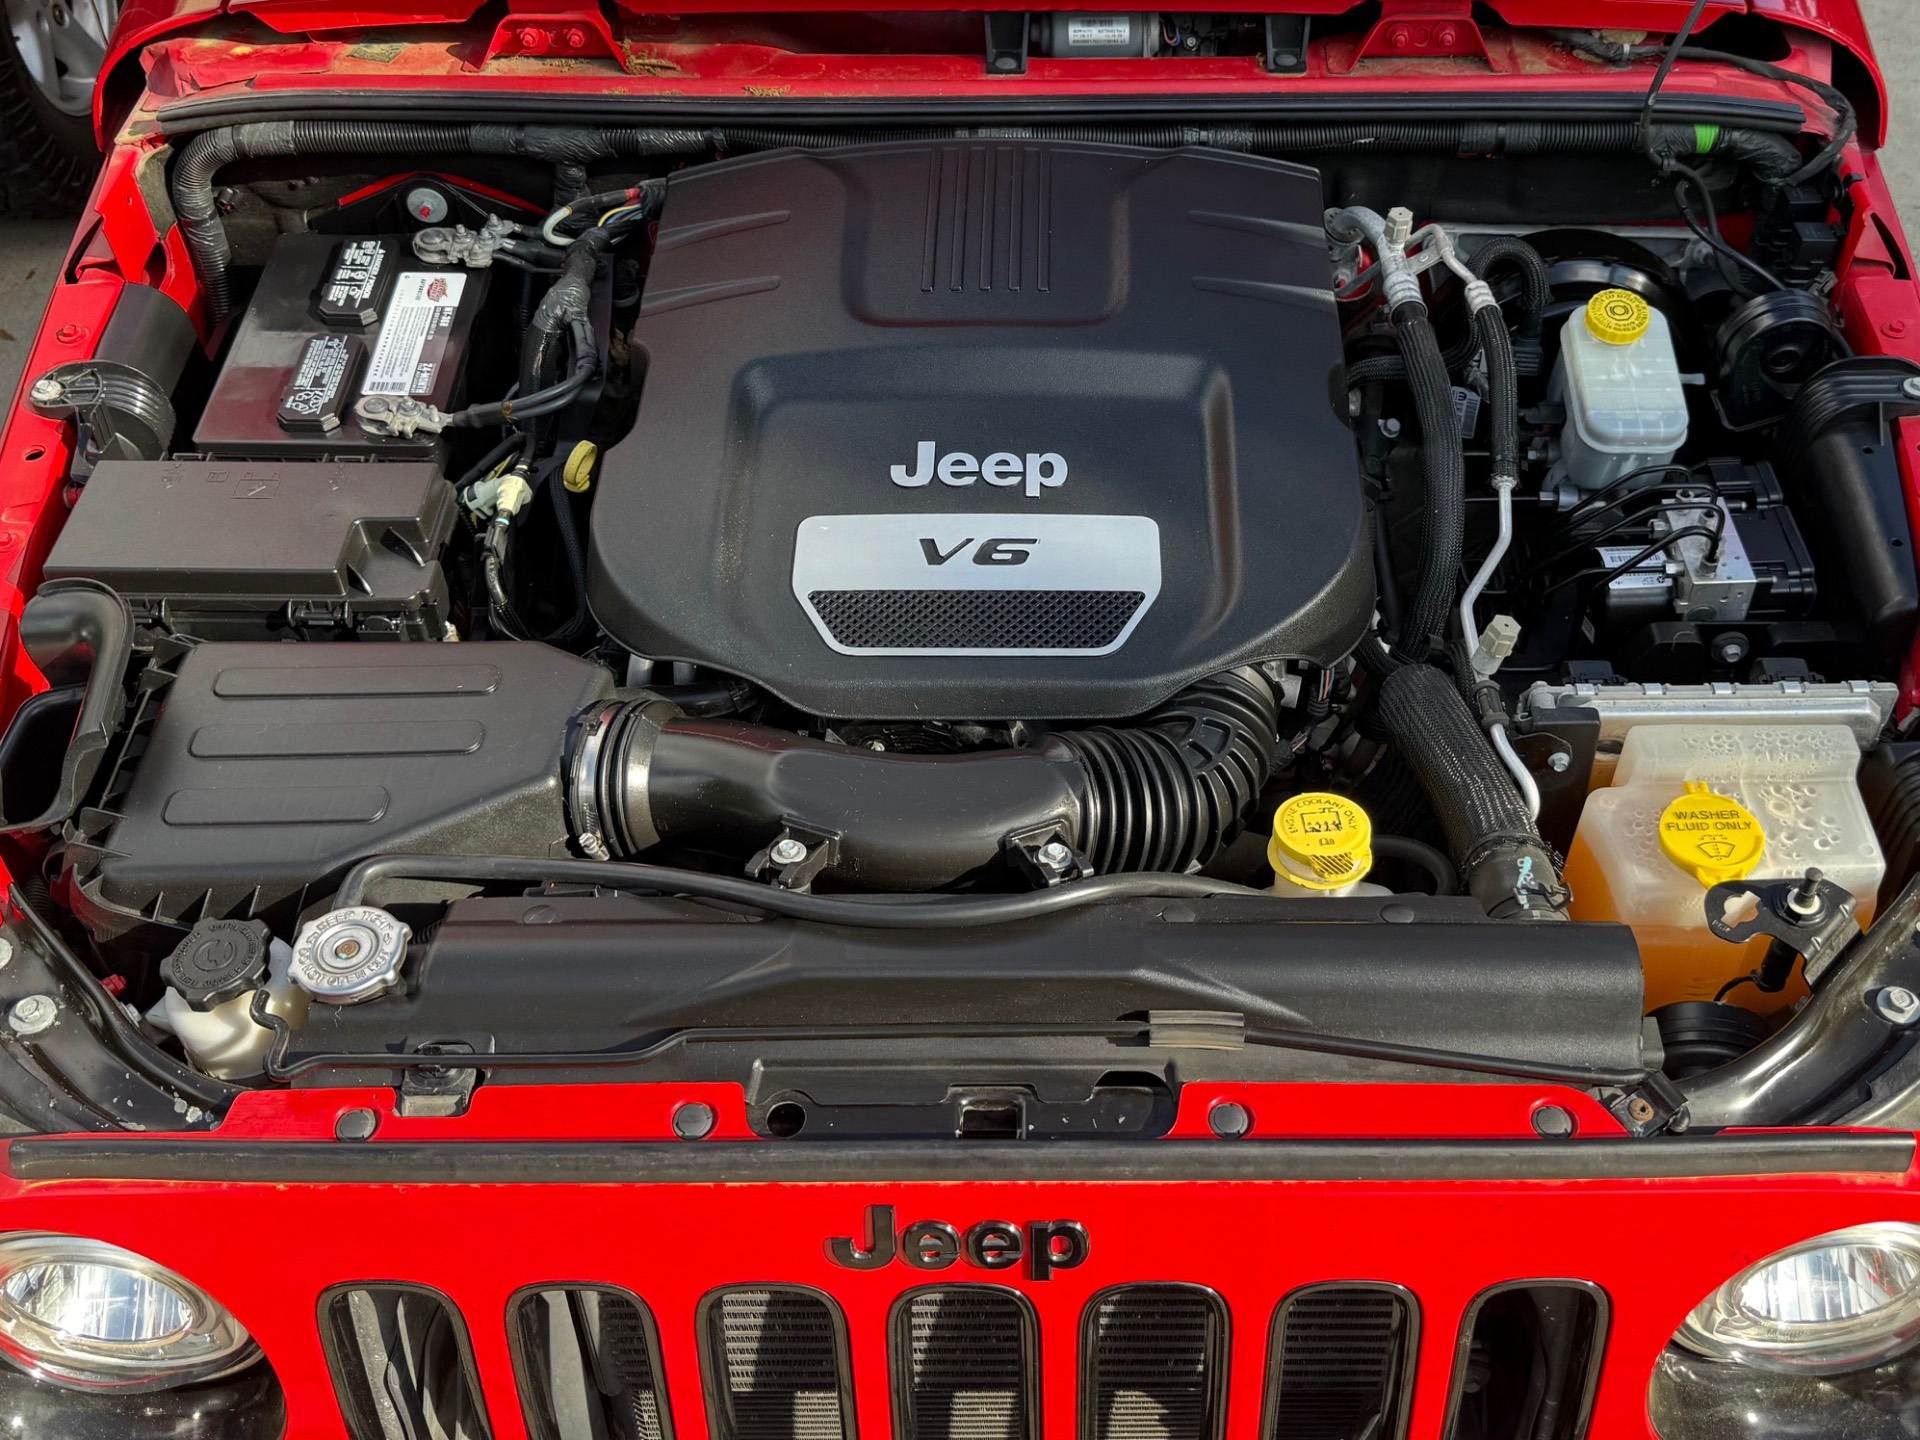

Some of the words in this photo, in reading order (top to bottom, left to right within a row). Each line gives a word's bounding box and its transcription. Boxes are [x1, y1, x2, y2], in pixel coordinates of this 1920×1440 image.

[890, 441, 1068, 498] Jeep
[919, 538, 1037, 566] V6
[1286, 807, 1298, 834] ENGINE
[1296, 798, 1346, 810] COOLANT
[1344, 810, 1358, 830] ONLY
[1666, 821, 1710, 831] FLUID
[1714, 821, 1752, 831] ONLY
[1674, 810, 1740, 820] WASHER
[316, 910, 355, 932] KEEP
[361, 910, 394, 932] TIGHT
[301, 964, 327, 985] NOT
[327, 969, 368, 986] OPEN
[823, 1204, 1091, 1282] Jeep
